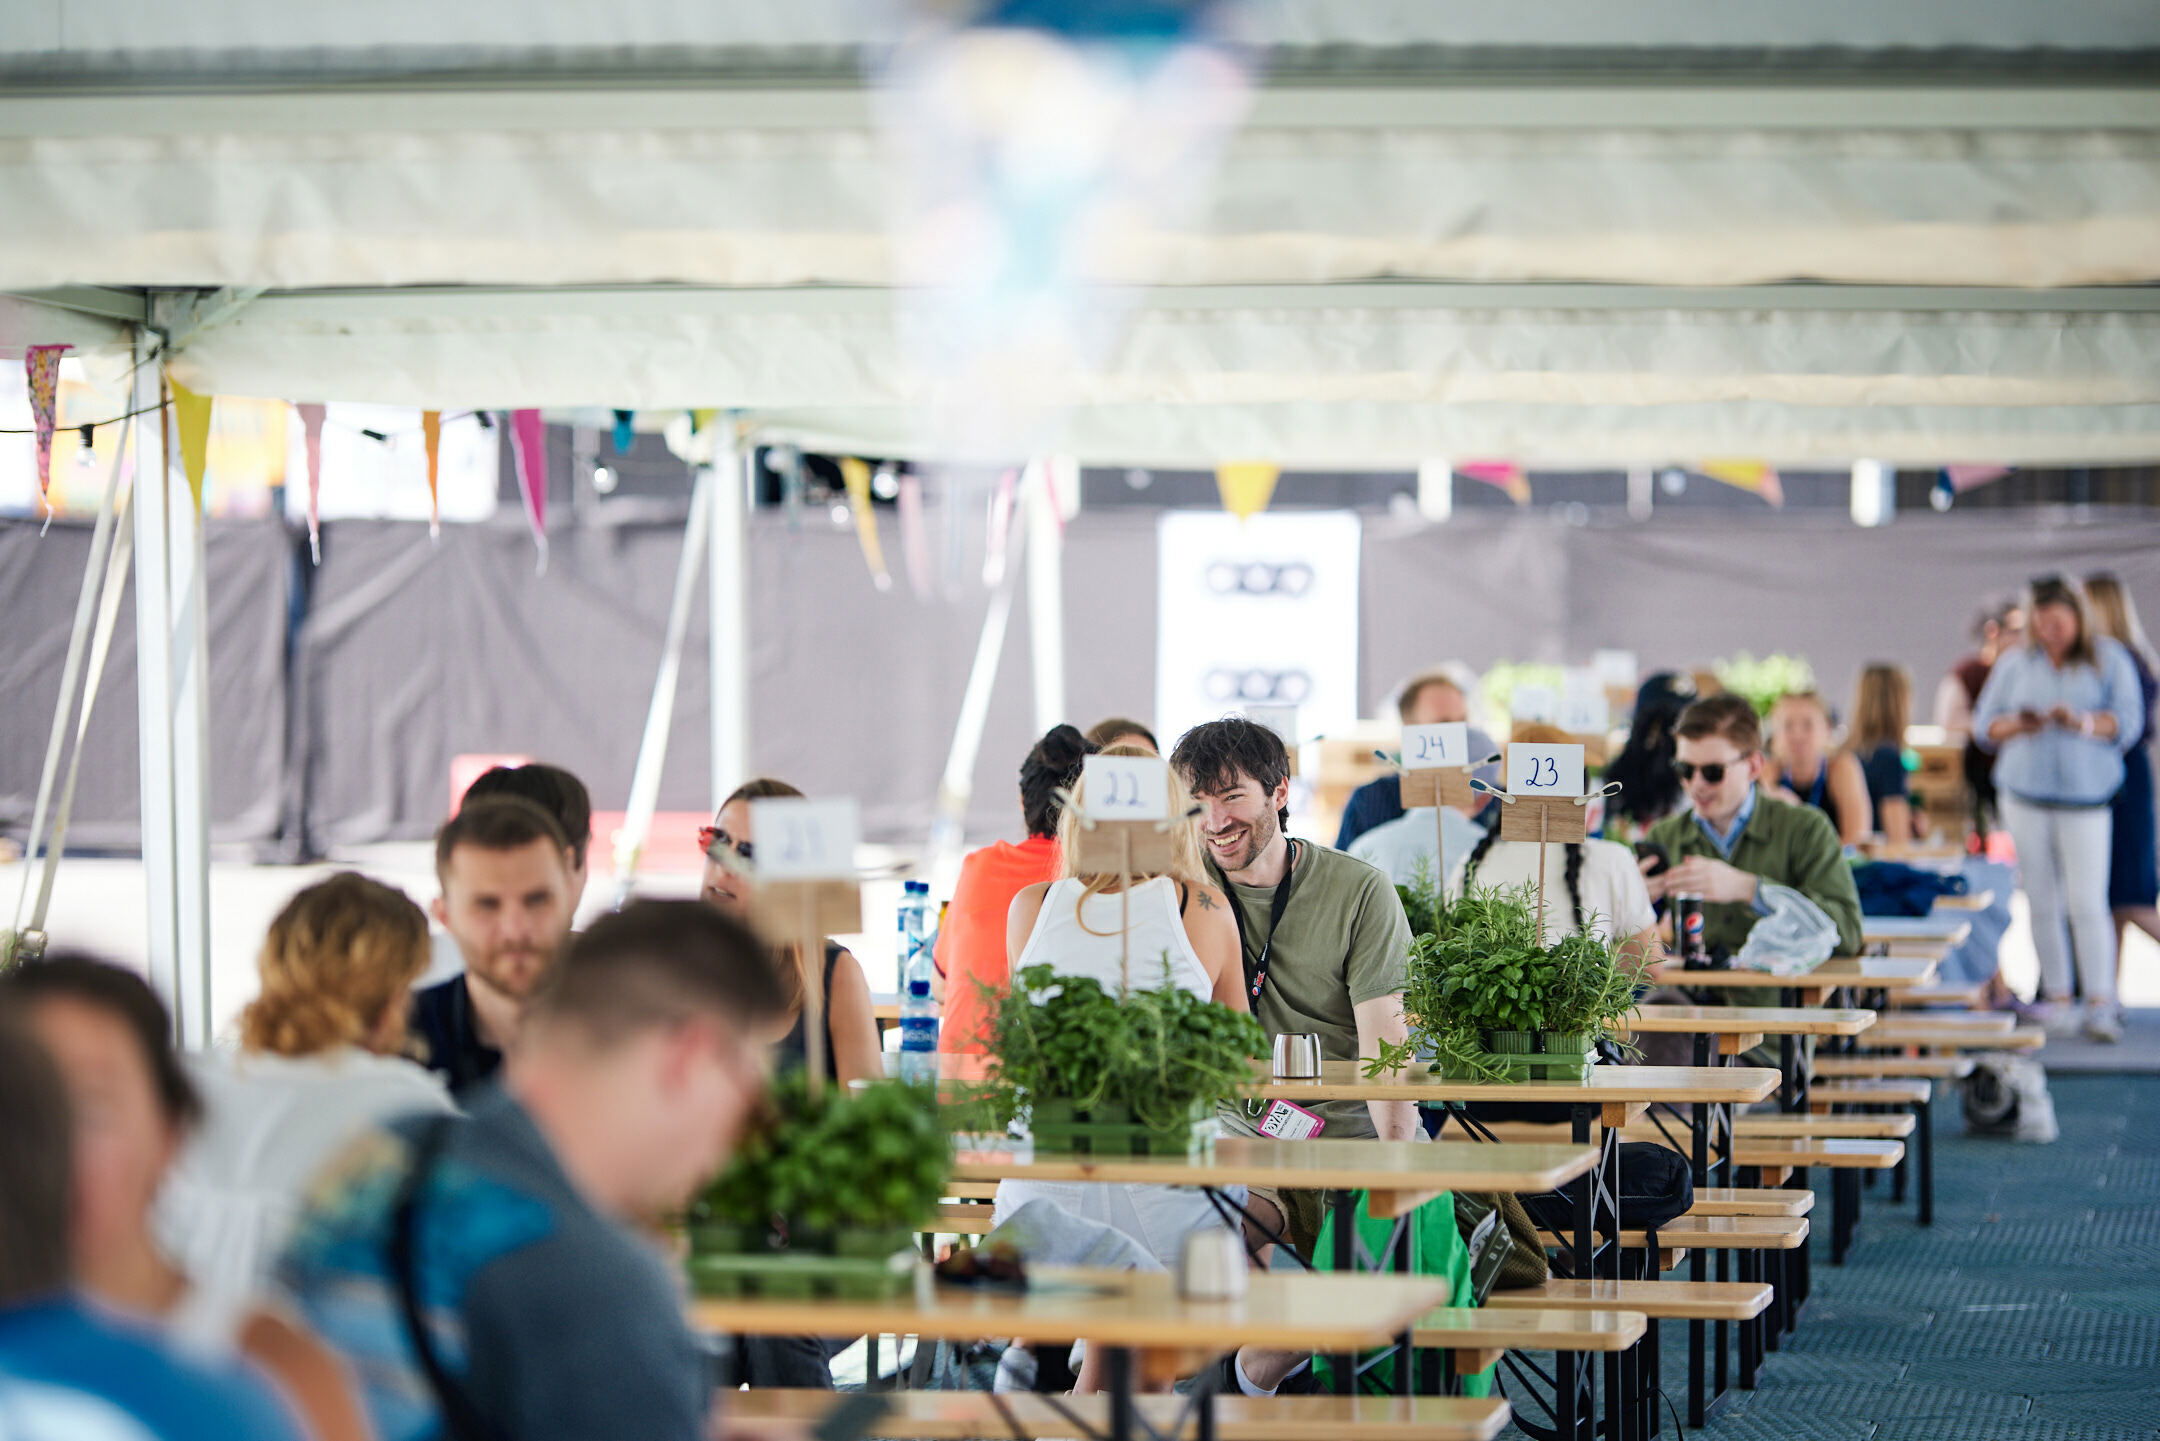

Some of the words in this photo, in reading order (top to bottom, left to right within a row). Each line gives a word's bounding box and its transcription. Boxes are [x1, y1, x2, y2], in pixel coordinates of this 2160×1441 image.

[1416, 735, 1445, 760] 24
[1526, 757, 1558, 787] 23
[1103, 771, 1147, 807] 22
